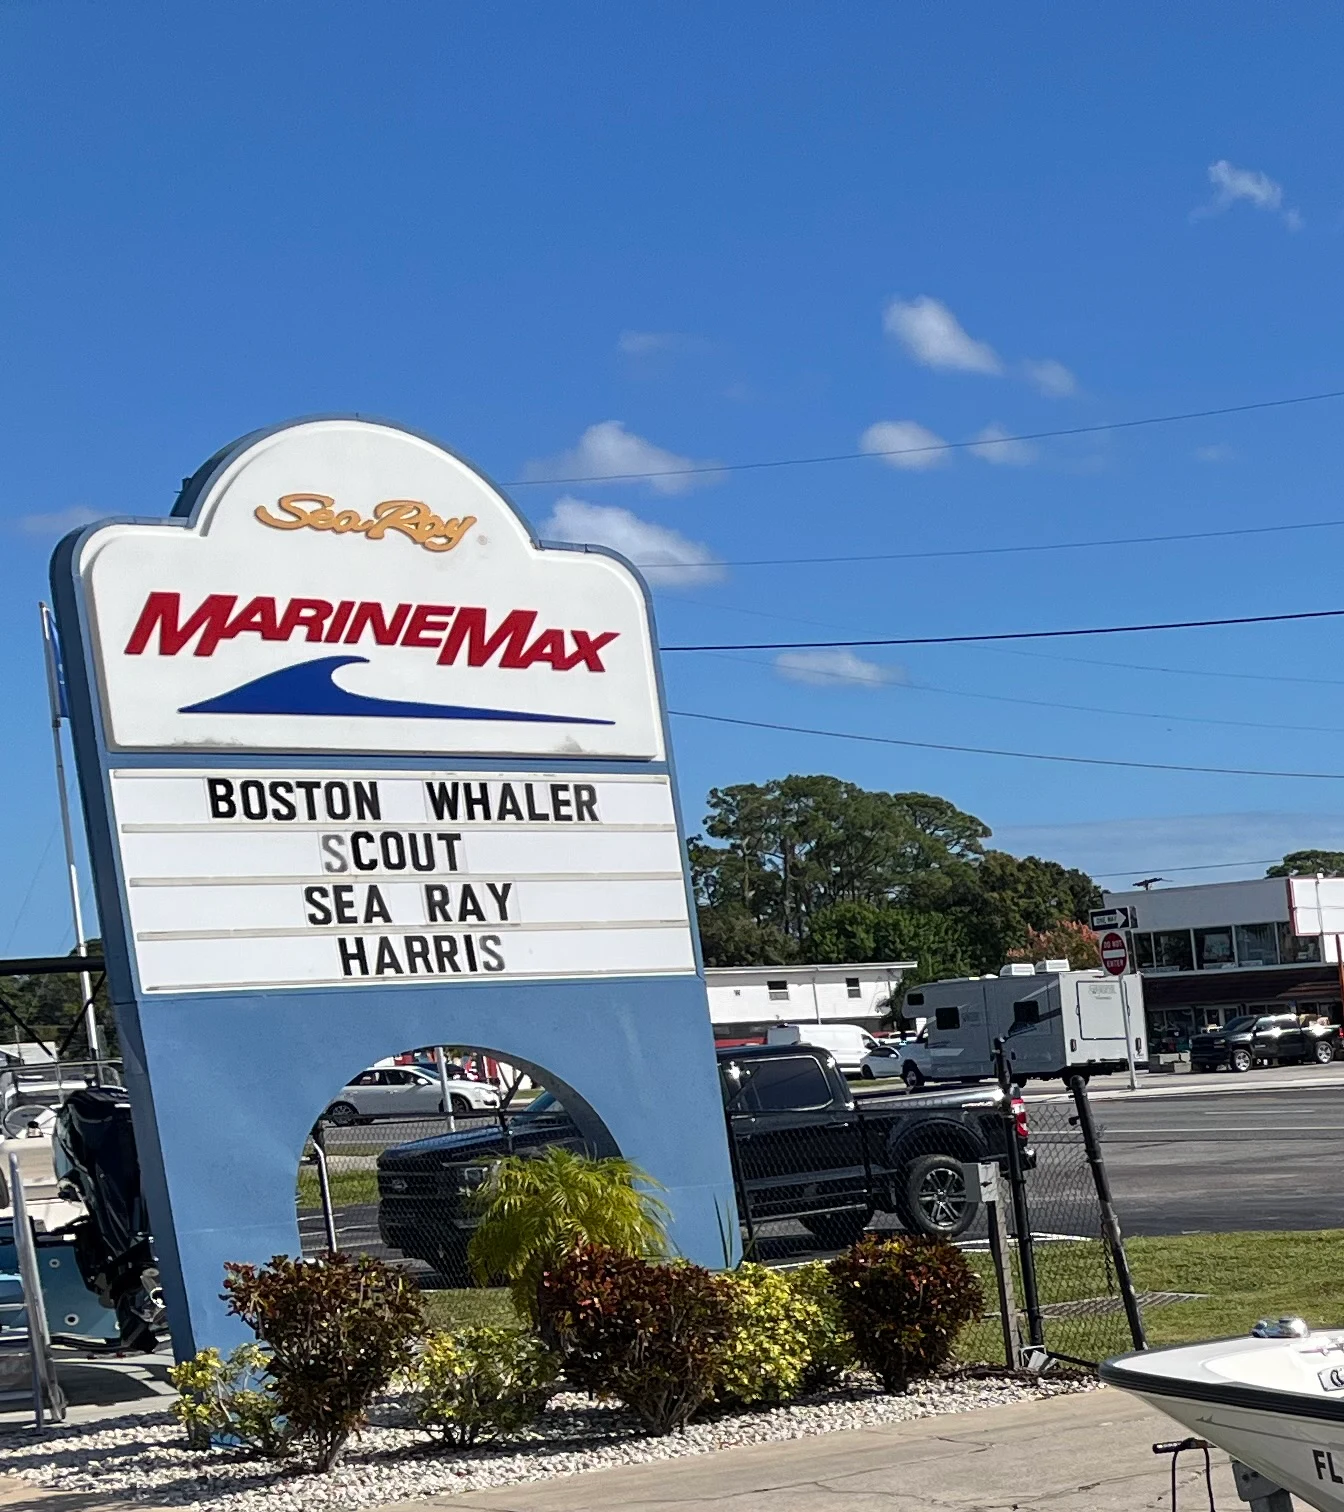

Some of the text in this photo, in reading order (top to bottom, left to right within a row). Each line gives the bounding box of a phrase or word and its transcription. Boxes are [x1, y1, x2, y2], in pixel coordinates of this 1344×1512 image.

[254, 493, 477, 552] Sea Ray
[207, 778, 600, 822] BOSTON WHALER
[321, 831, 462, 873] SCOUT
[304, 882, 512, 926] SEA RAY
[338, 934, 506, 976] HARRIS
[1106, 959, 1124, 968] ENTER
[1112, 939, 1123, 947] NOT
[1312, 1449, 1344, 1484] FL
